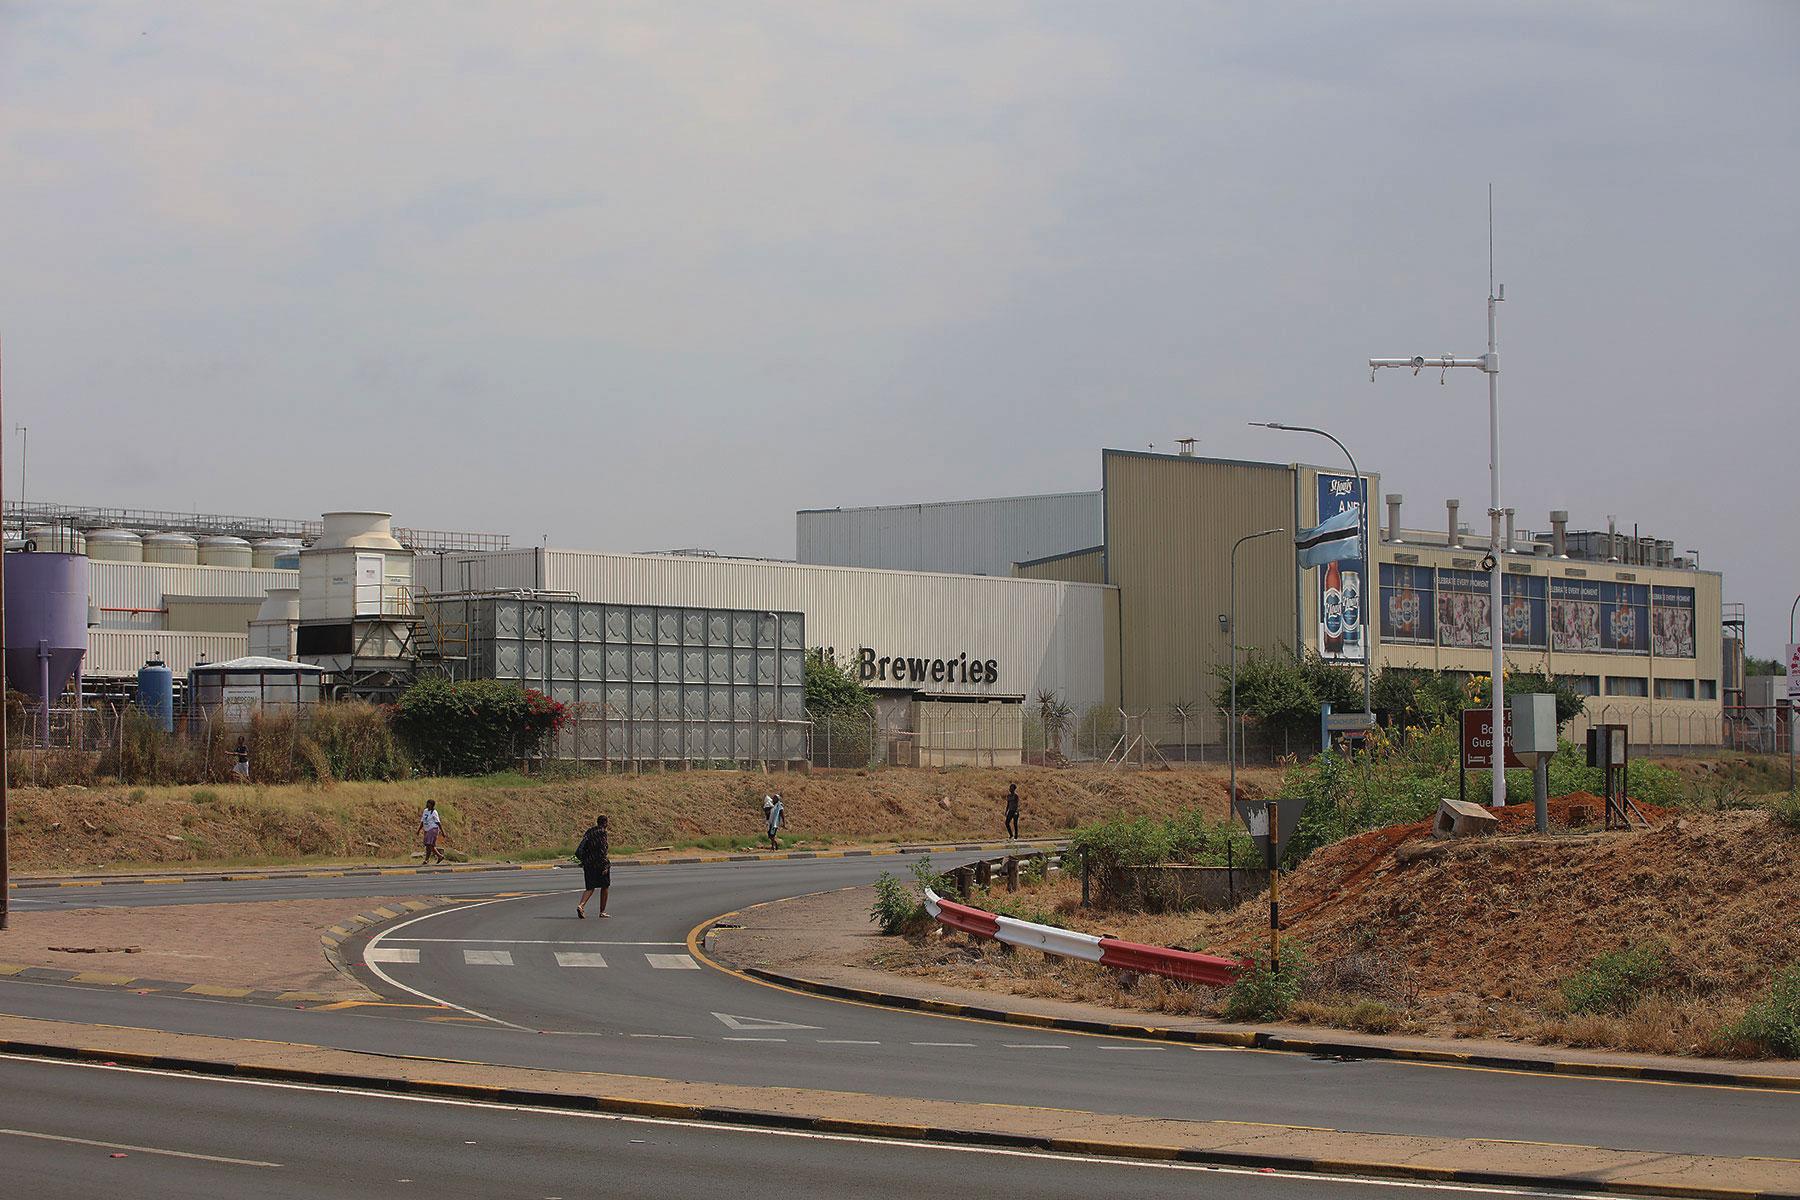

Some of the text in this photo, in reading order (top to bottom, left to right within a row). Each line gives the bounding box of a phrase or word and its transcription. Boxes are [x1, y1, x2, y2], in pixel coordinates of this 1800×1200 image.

[1338, 500, 1346, 513] A
[1457, 578, 1469, 586] EVERY
[1568, 586, 1580, 595] EVERY
[859, 647, 998, 684] Breweries
